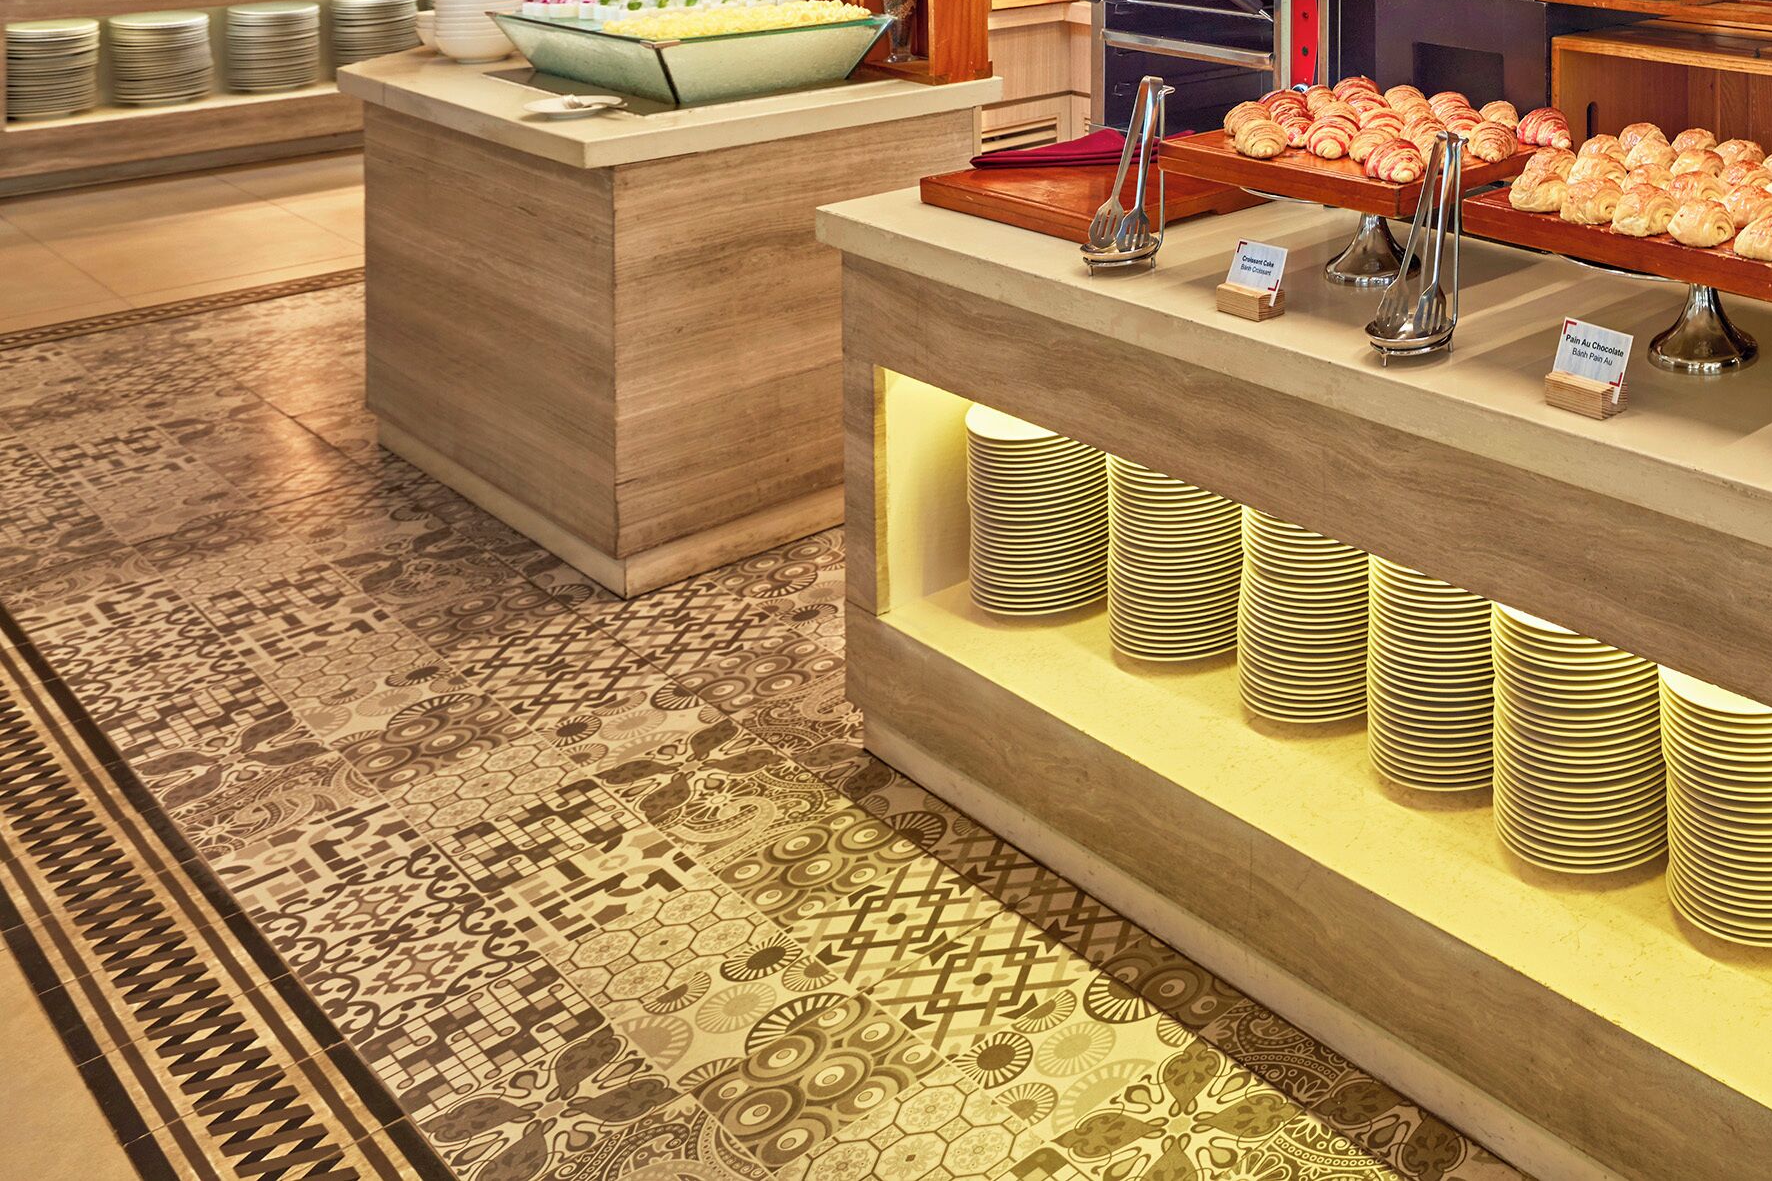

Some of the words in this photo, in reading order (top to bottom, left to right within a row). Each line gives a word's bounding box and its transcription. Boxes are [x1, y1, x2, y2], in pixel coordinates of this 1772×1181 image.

[1242, 255, 1263, 266] Croissant
[1263, 260, 1275, 268] Cake
[1252, 266, 1272, 276] Croissant
[1566, 334, 1580, 345] Pain
[1581, 339, 1591, 348] Au
[1591, 341, 1624, 358] Chocolate
[1572, 347, 1588, 357] Bánh
[1589, 352, 1602, 363] Pain
[1603, 357, 1613, 366] Au
